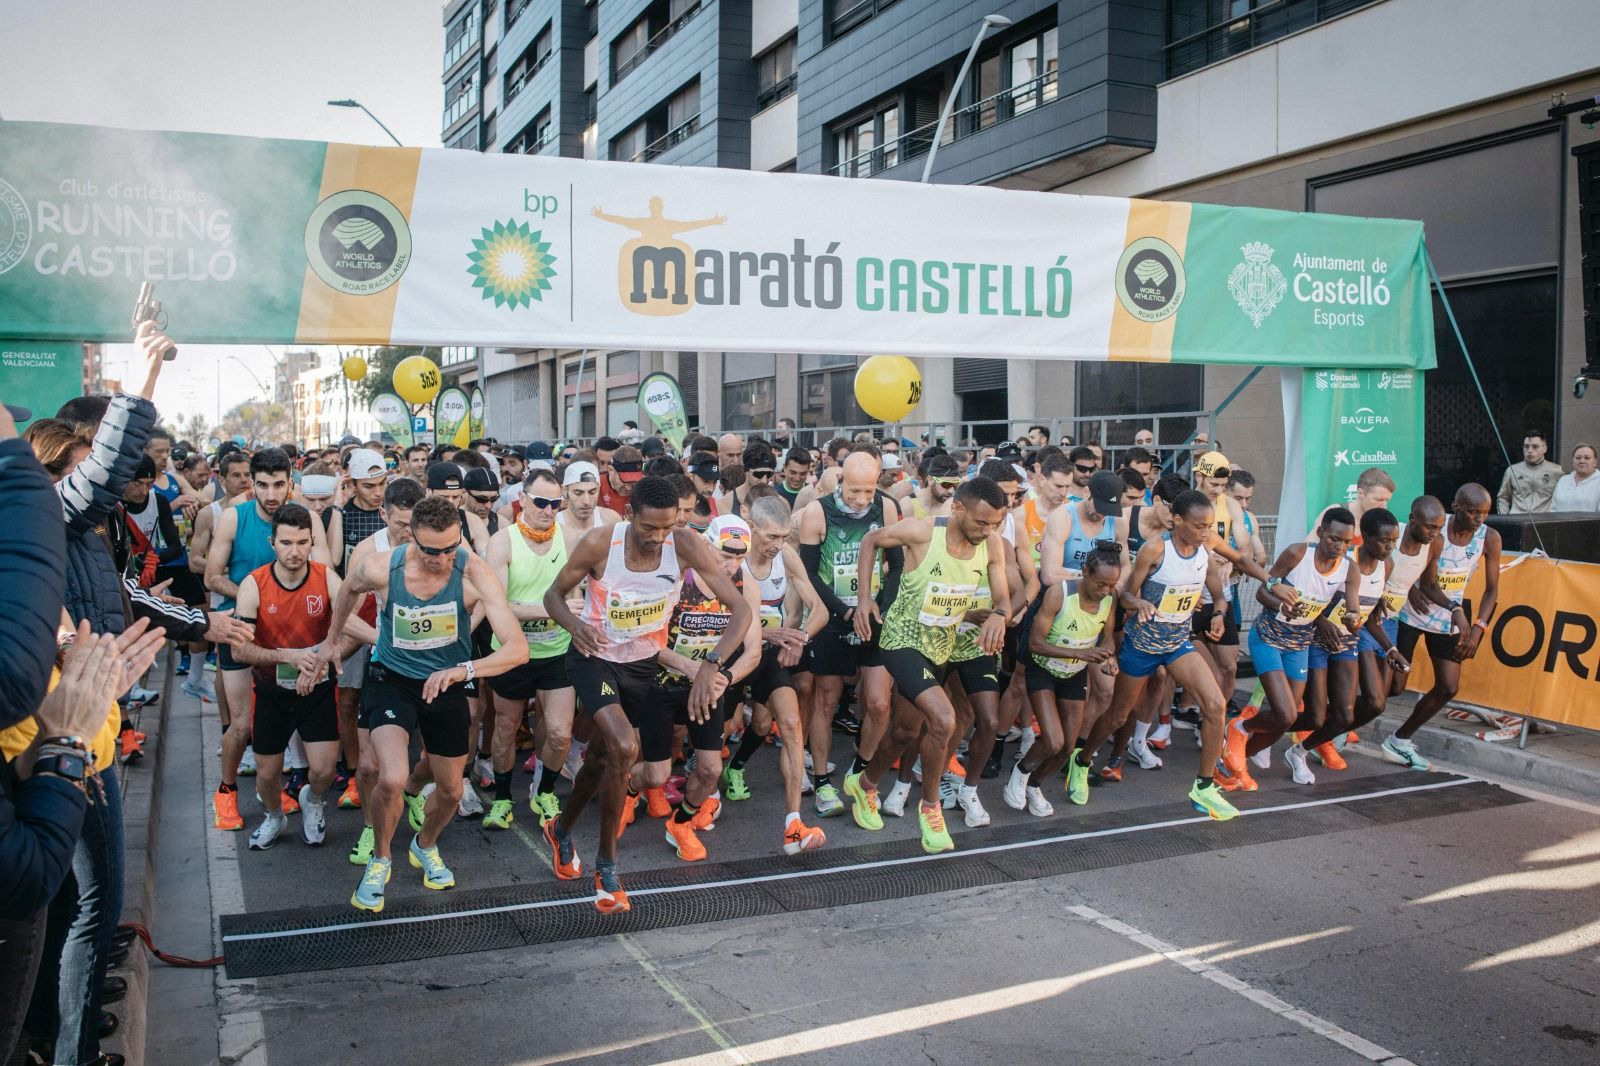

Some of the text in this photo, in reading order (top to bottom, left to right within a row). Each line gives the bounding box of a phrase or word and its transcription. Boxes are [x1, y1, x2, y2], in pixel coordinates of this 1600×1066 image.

[59, 178, 98, 196] Club
[524, 188, 558, 218] bp
[37, 201, 233, 241] RUNNING
[342, 253, 375, 261] WORLD
[1293, 252, 1387, 274] Ajuntament de
[335, 260, 382, 270] ATHLETICS
[342, 254, 407, 291] ROAD RACE LABEL
[630, 238, 1073, 319] marató CASTELLÓ
[1140, 287, 1161, 295] WORLD
[1293, 272, 1391, 306] Castelló
[1134, 293, 1166, 303] ATHLETICS
[1138, 310, 1155, 319] ROAD
[1314, 309, 1365, 329] Esports
[2, 351, 57, 360] GENERALITAT
[2, 359, 56, 367] VALENCIANA
[415, 418, 424, 430] P
[1341, 416, 1390, 424] BAVIERA
[1352, 450, 1397, 463] CaixaBank
[931, 596, 968, 607] MUKTAR
[1176, 596, 1192, 611] 15
[610, 603, 665, 619] GEMECHU
[945, 607, 951, 616] 3
[635, 617, 641, 626] 1
[684, 616, 730, 624] PRECISION
[410, 619, 432, 634] 39
[691, 648, 708, 661] 24
